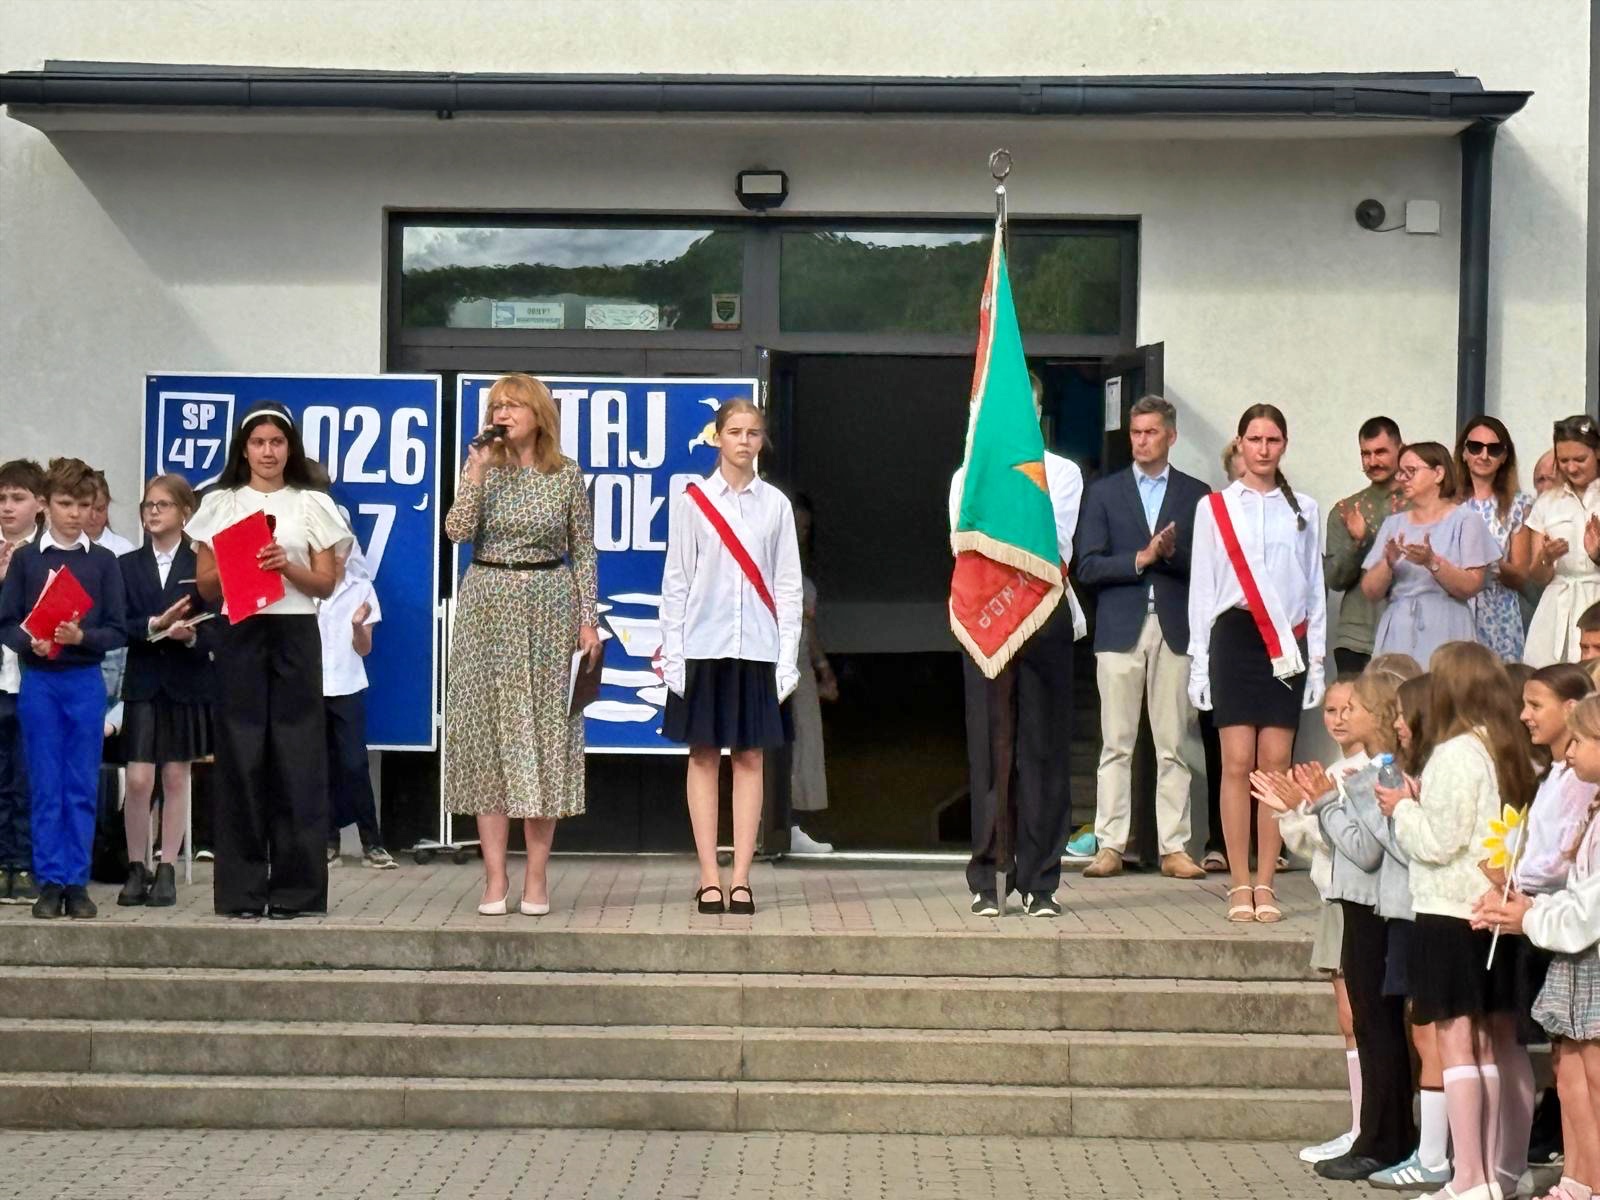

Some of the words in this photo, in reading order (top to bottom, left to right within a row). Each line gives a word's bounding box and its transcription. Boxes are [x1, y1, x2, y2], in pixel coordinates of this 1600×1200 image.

[182, 403, 216, 430] SP
[284, 404, 429, 485] 026
[479, 388, 666, 469] TAJ
[168, 438, 222, 470] 47
